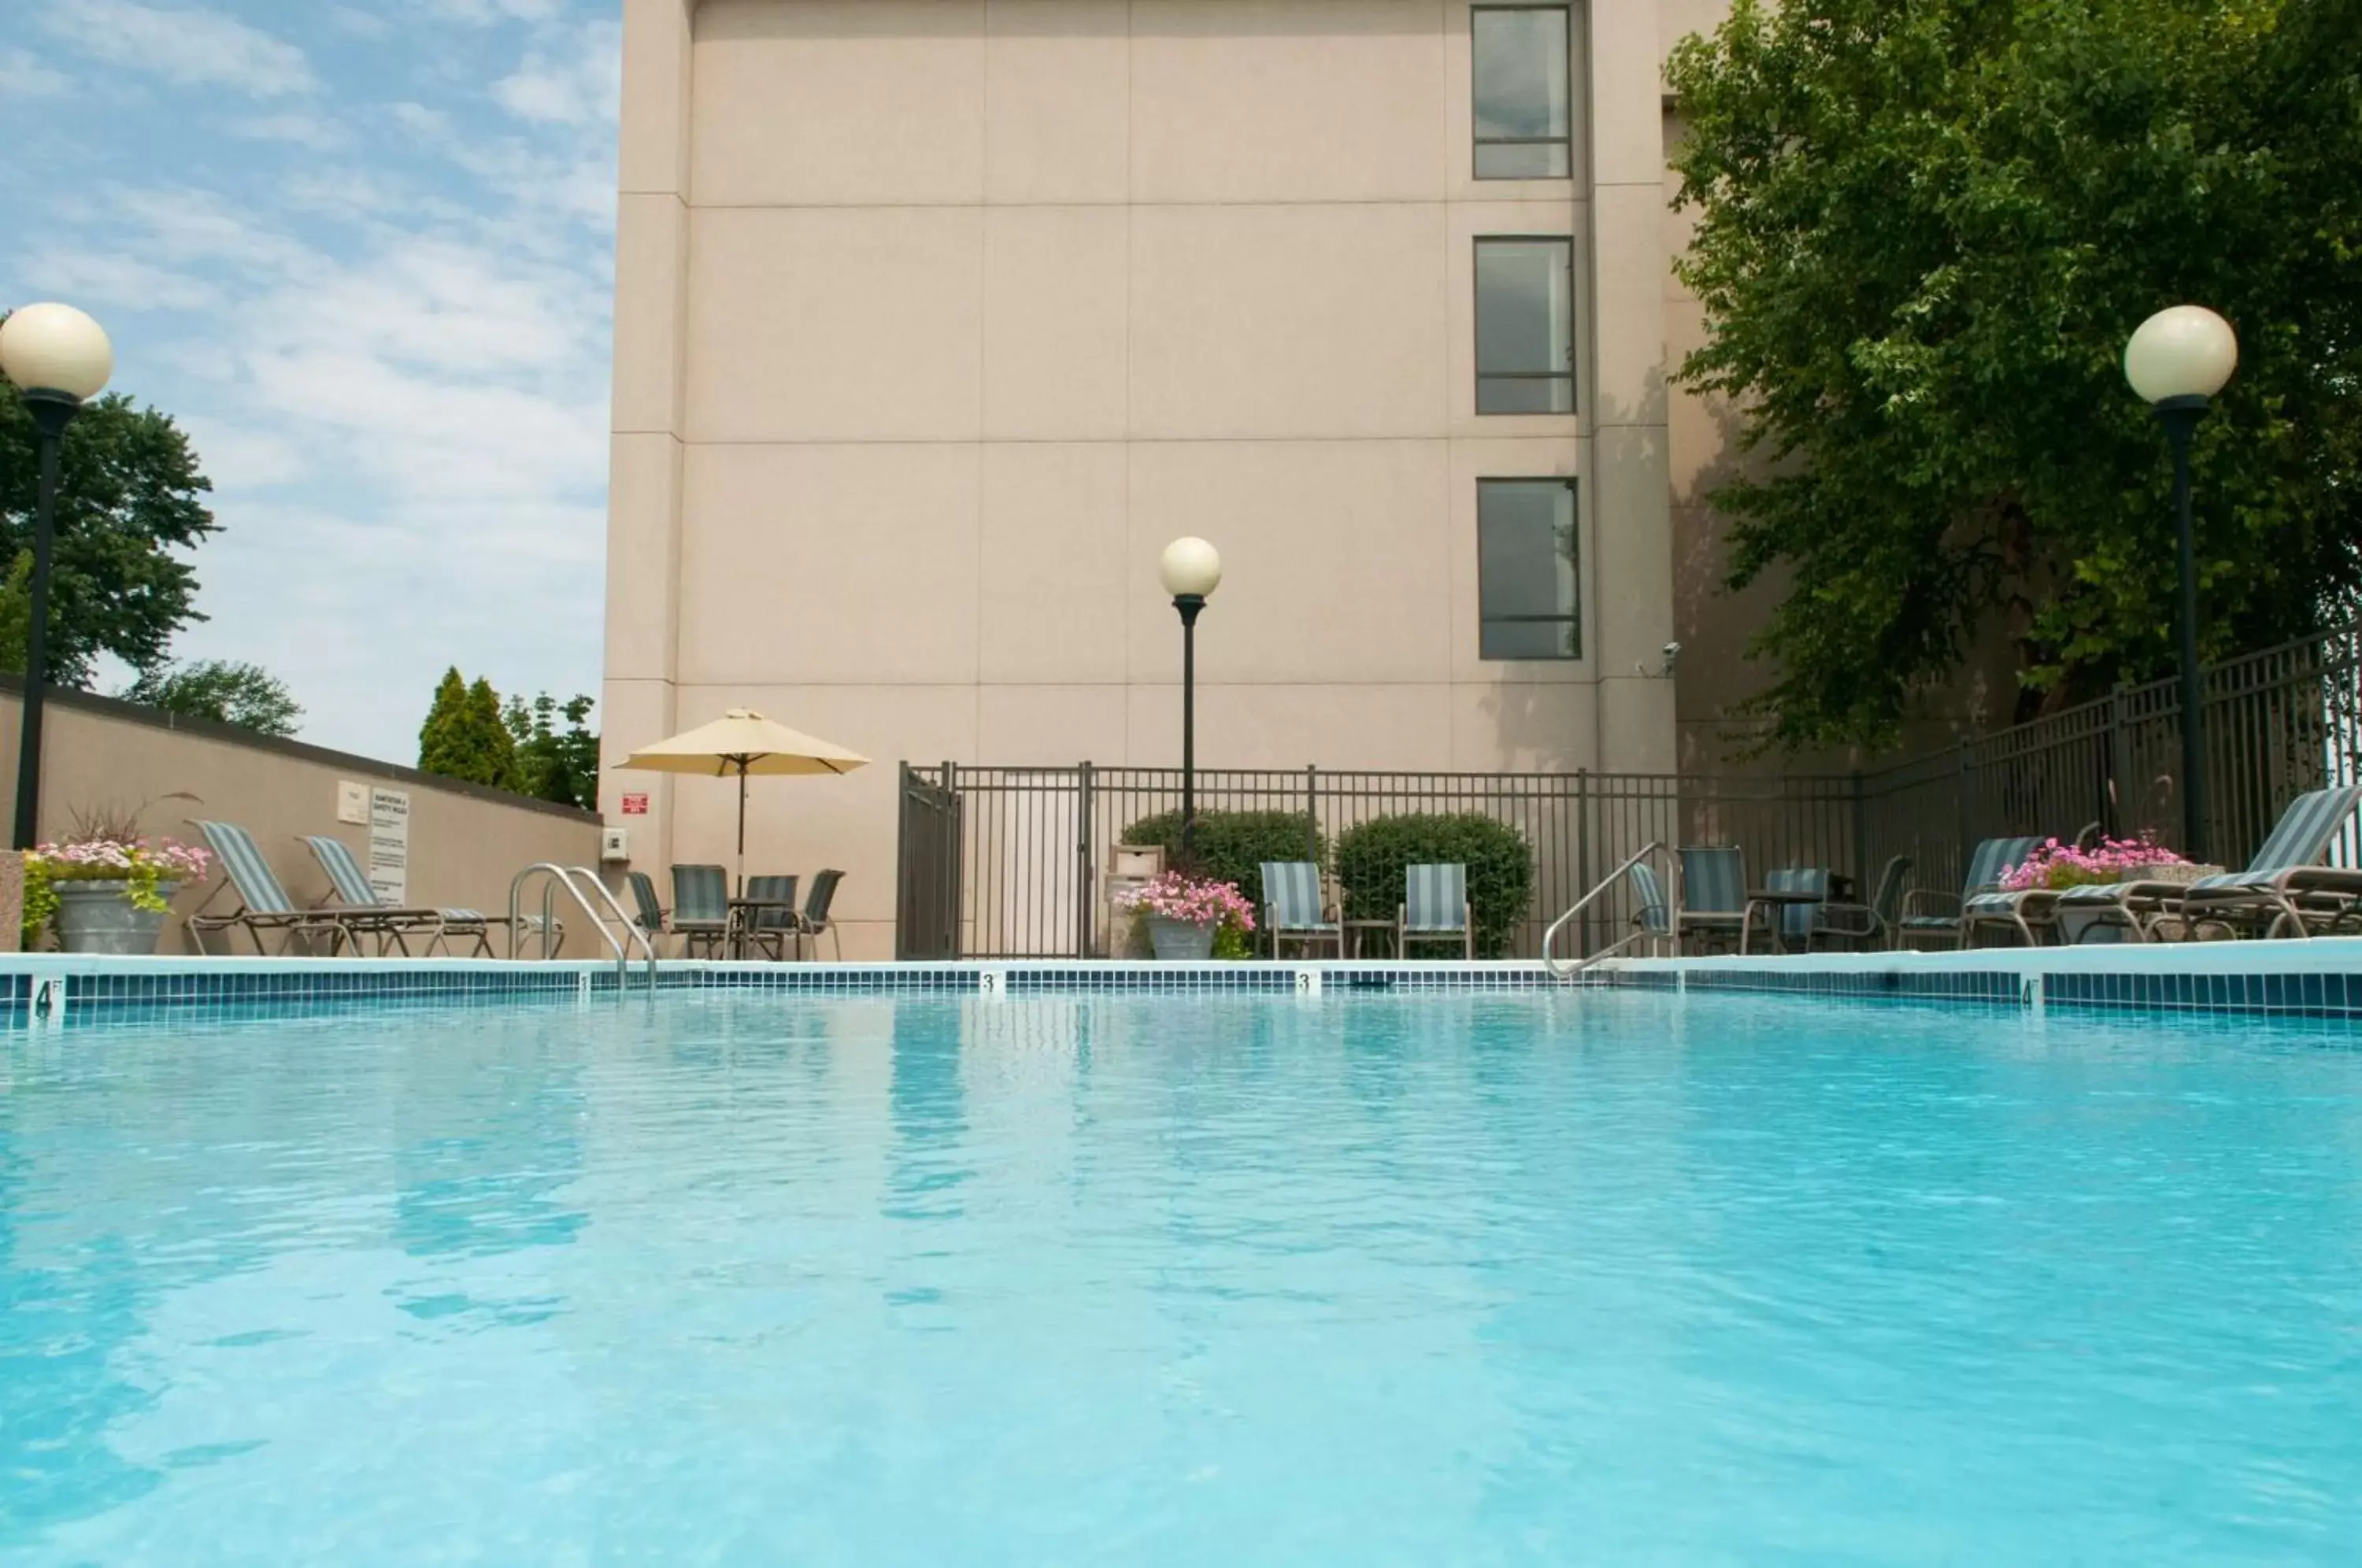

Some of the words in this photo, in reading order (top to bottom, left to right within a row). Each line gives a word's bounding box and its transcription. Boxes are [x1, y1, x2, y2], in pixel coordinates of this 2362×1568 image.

[983, 974, 994, 991] 3
[1299, 973, 1309, 991] 3
[2023, 978, 2032, 1008] 4
[36, 981, 52, 1011] 4
